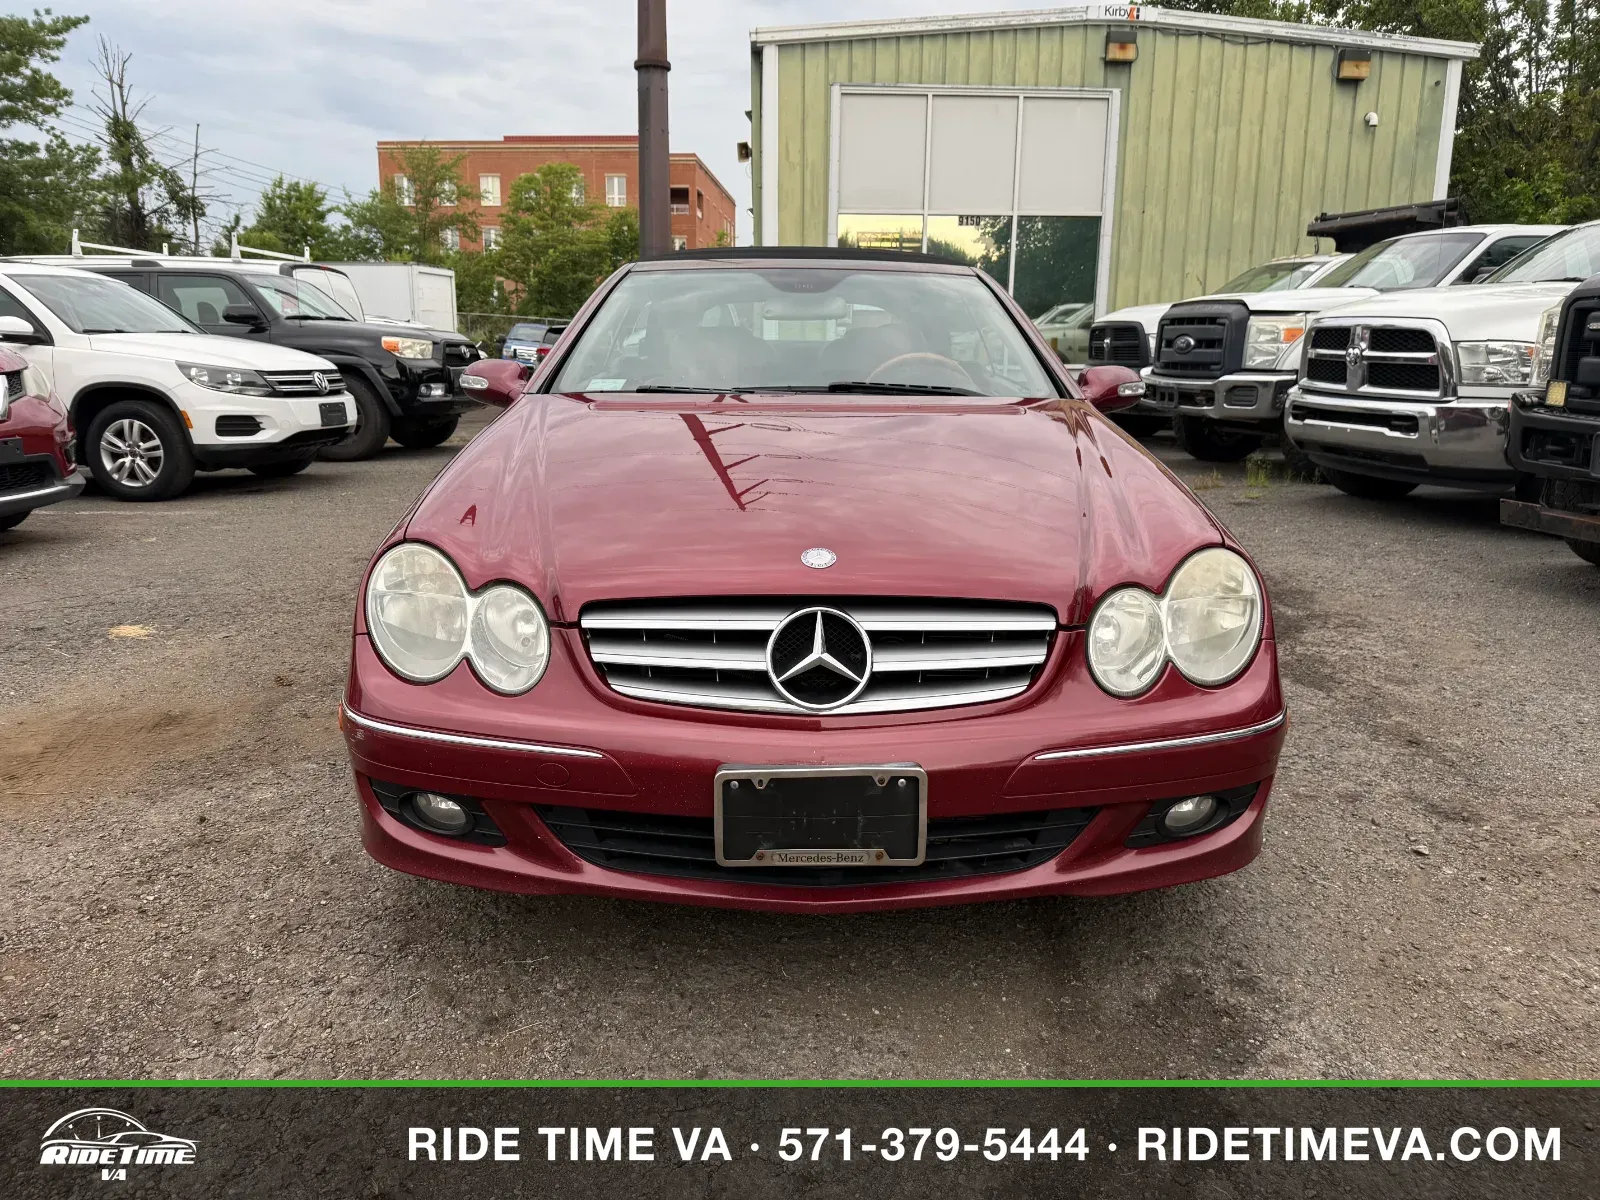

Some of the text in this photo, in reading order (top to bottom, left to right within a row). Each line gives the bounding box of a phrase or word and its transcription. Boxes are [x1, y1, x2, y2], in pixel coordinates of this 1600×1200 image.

[1104, 5, 1131, 19] Kirby
[958, 215, 981, 226] 9150
[777, 852, 865, 863] Mercedes-Benz
